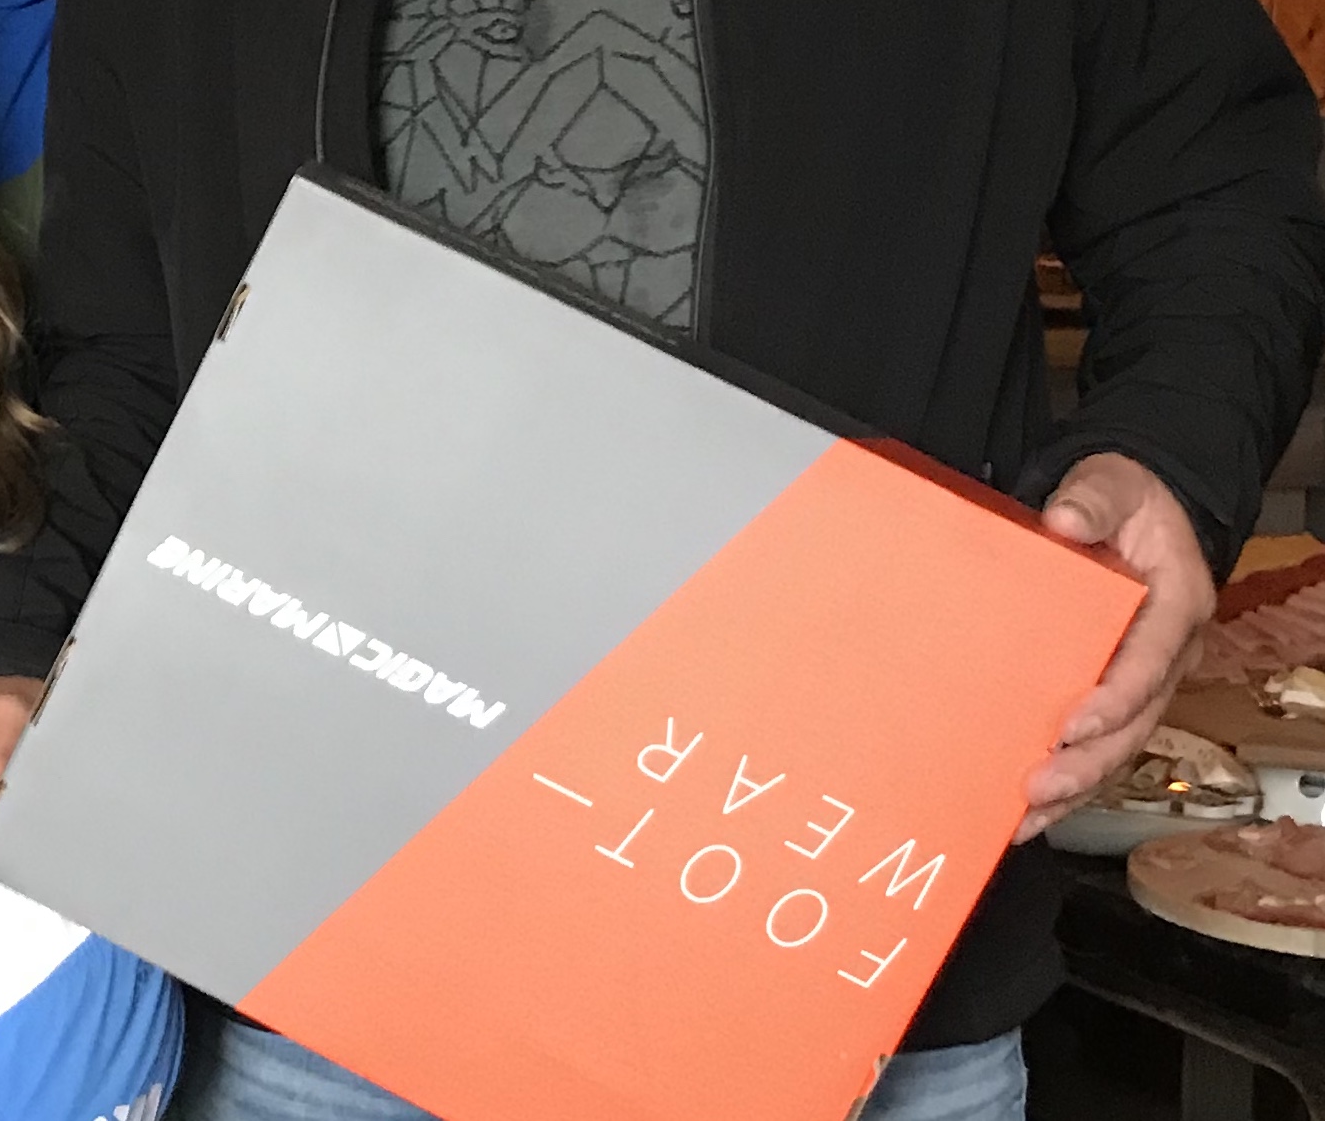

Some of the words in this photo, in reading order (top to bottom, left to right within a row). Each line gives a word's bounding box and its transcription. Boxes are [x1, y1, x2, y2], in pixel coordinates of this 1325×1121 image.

[146, 535, 330, 639] MARINE
[349, 638, 506, 728] MAGIC
[637, 717, 945, 910] WEAR
